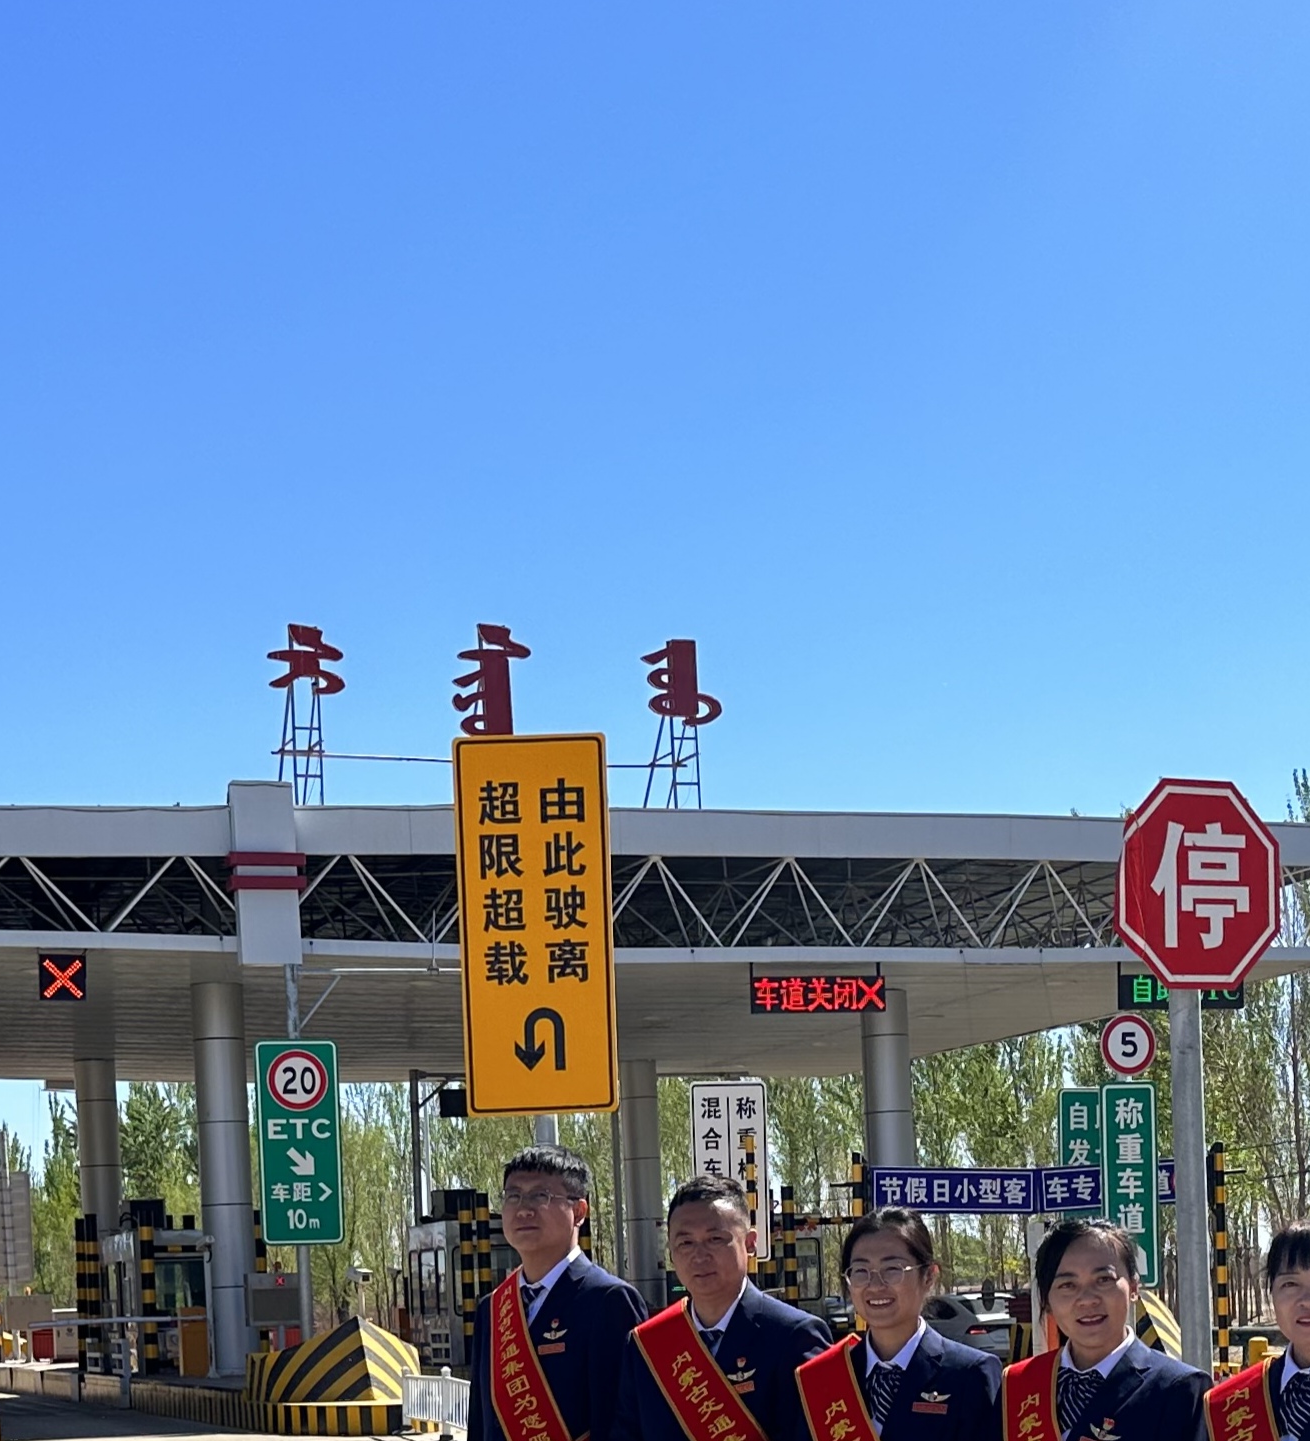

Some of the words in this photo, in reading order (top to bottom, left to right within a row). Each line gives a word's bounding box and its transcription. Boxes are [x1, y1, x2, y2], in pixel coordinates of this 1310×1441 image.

[478, 780, 528, 985] 超限超载
[539, 778, 589, 984] 由此驶离
[1150, 821, 1250, 949] 停
[1121, 1031, 1138, 1057] 5
[282, 1067, 316, 1095] 20
[267, 1118, 331, 1140] ETC
[1115, 1098, 1145, 1234] 称重车道
[879, 1175, 1027, 1206] 节假日小型客
[287, 1209, 321, 1230] 10m
